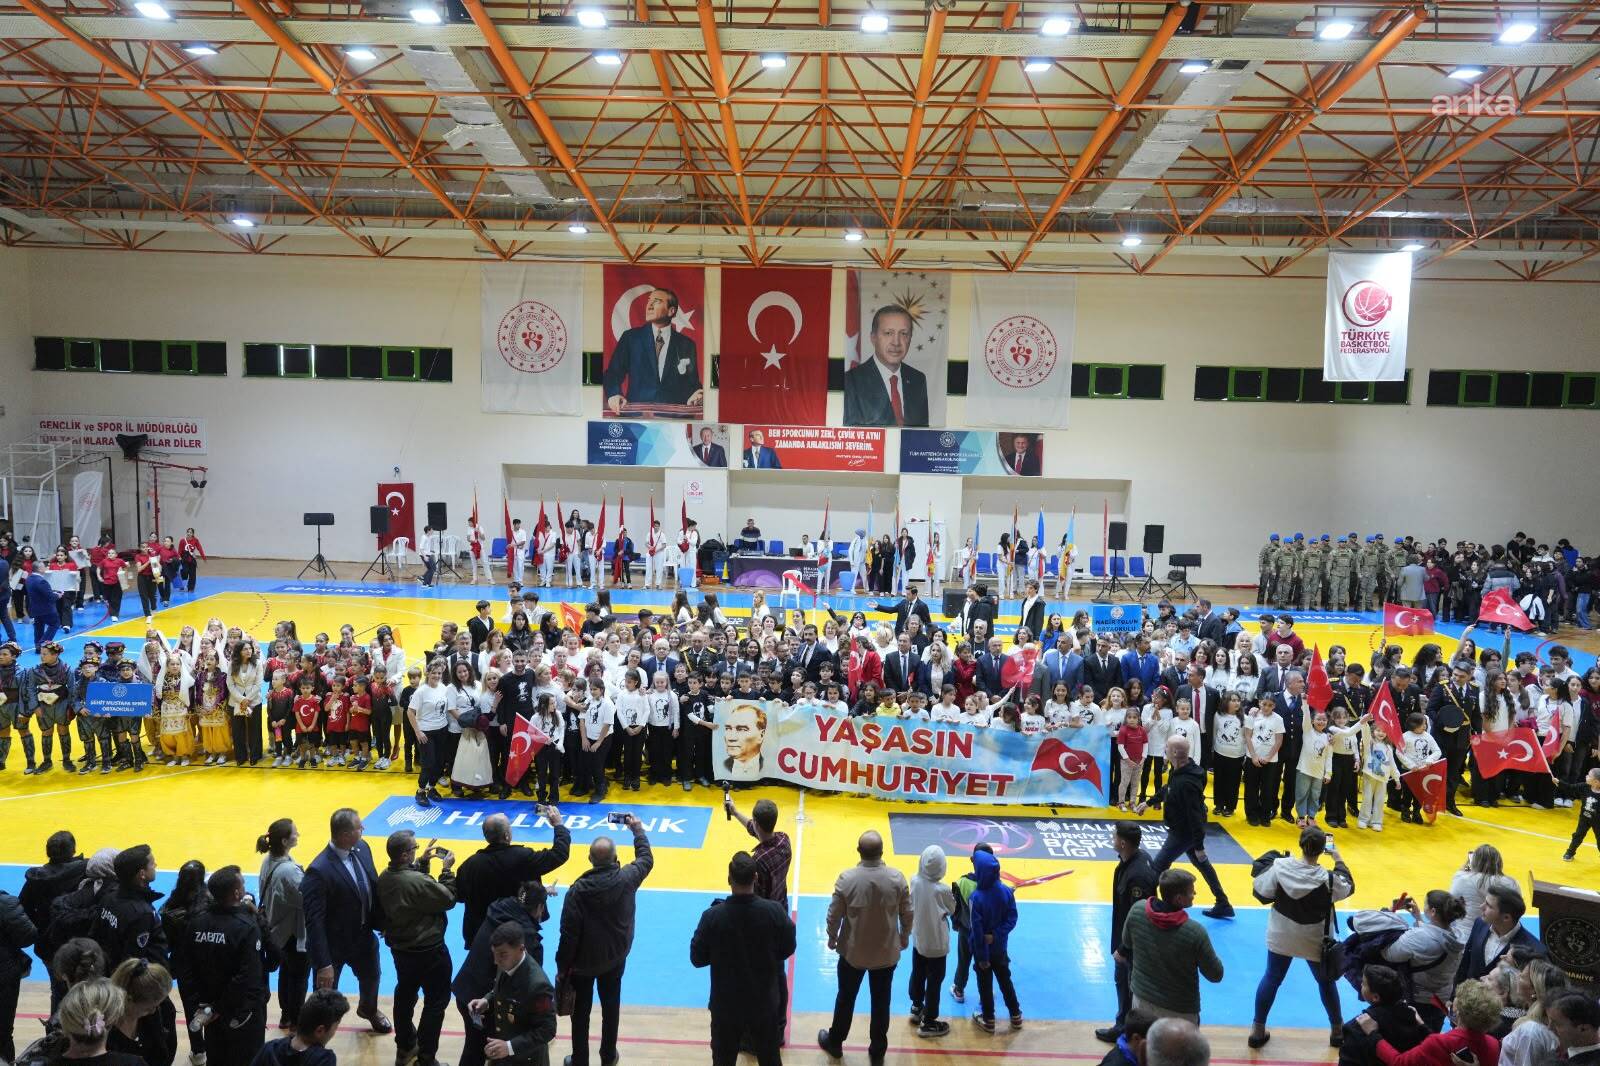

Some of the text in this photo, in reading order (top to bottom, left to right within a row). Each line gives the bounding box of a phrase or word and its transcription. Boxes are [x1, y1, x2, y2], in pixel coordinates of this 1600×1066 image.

[1341, 329, 1391, 341] TÜRKİYE
[1340, 340, 1391, 348] BASKETBOL
[84, 423, 95, 431] ve
[97, 422, 123, 432] SPOR
[125, 421, 134, 432] İL
[137, 421, 198, 434] MÜDÜRLÜĞÜ
[768, 428, 781, 438] BEN
[782, 429, 821, 439] SPORCUNUN
[857, 430, 865, 440] VE
[173, 437, 202, 448] DİLER
[775, 440, 806, 449] ZAMANDA
[814, 714, 973, 759] YAŞASIN
[442, 810, 689, 833] HLKBANK
[194, 931, 226, 945] ZABITA
